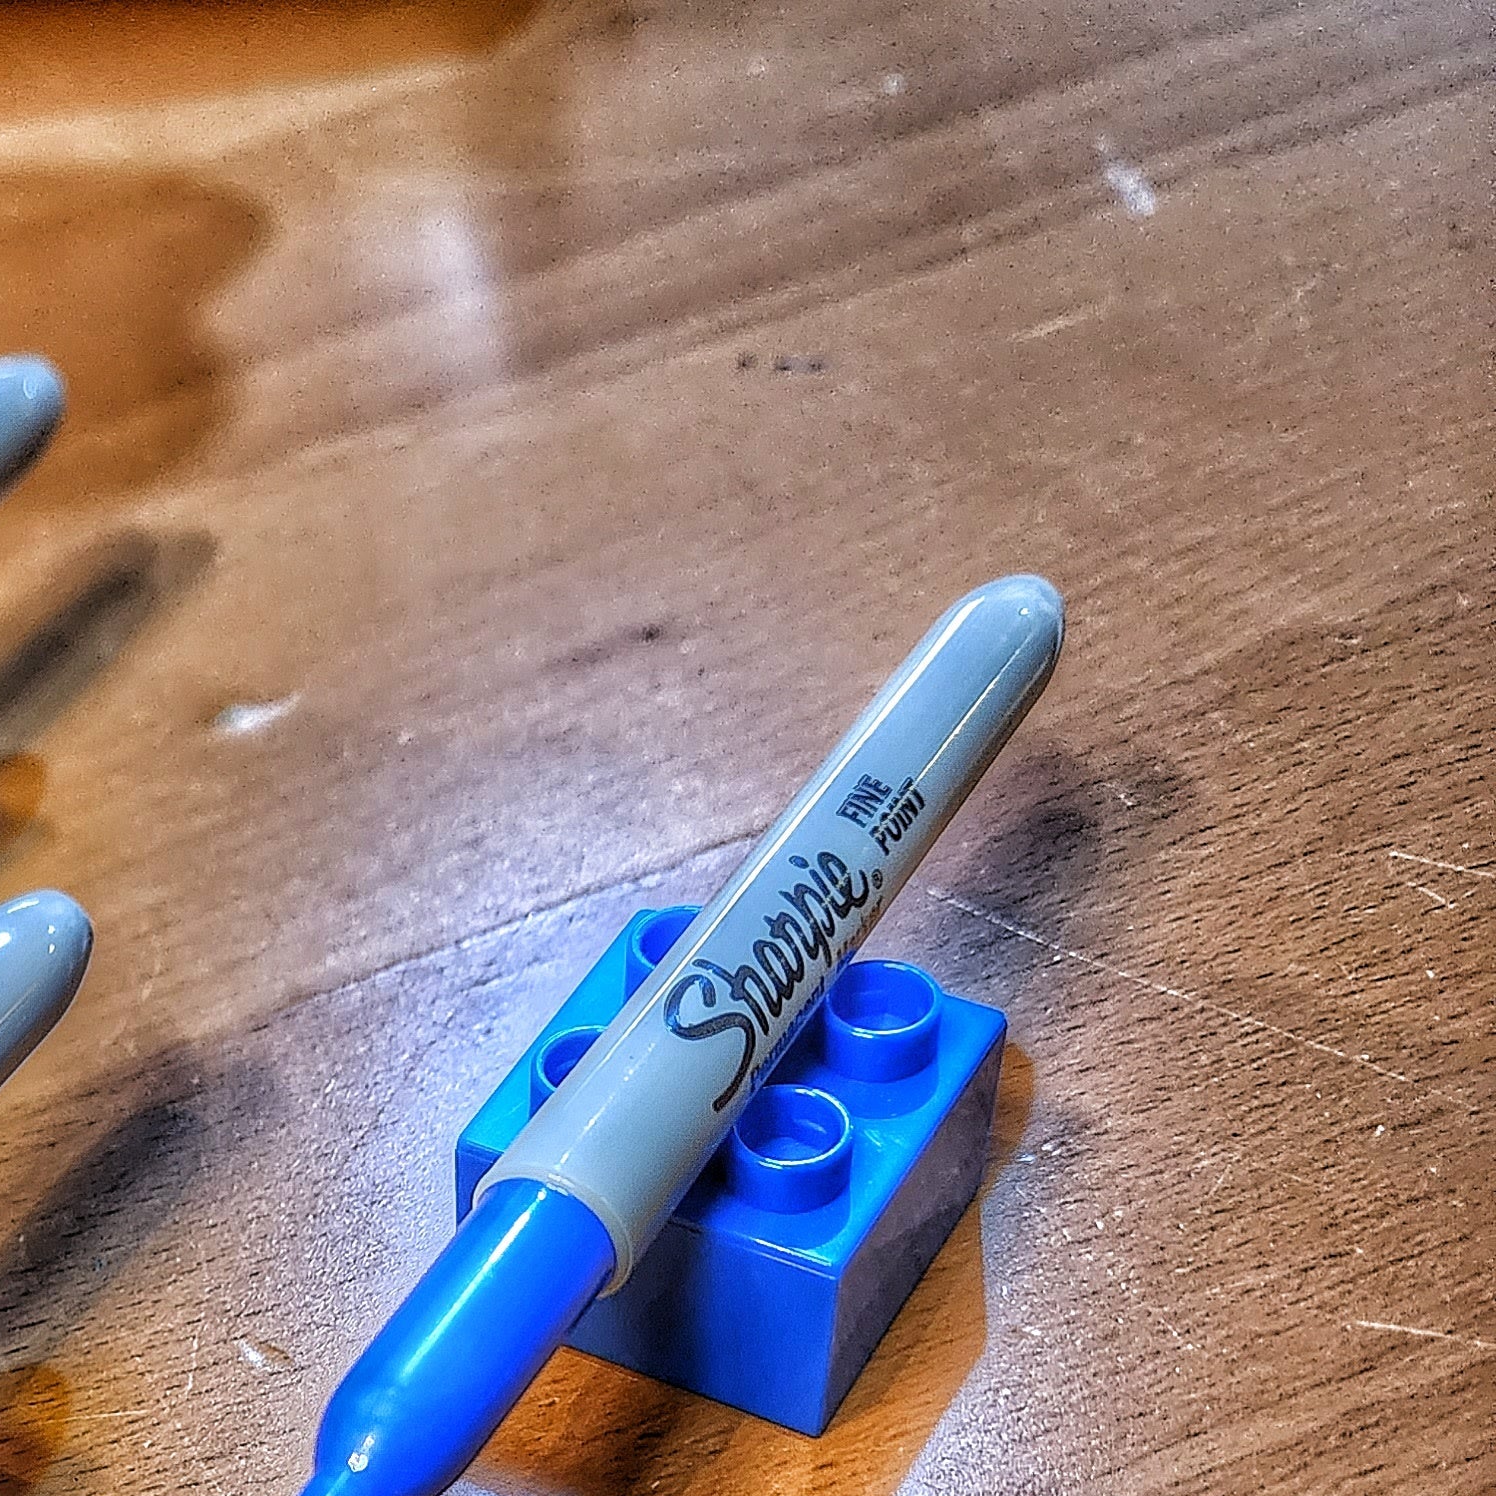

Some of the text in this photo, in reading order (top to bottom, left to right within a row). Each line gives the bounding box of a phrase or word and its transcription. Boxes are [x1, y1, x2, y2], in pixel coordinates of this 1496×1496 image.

[836, 773, 893, 829] FINE
[868, 776, 927, 856] POINT
[663, 851, 869, 1113] Sharpie
